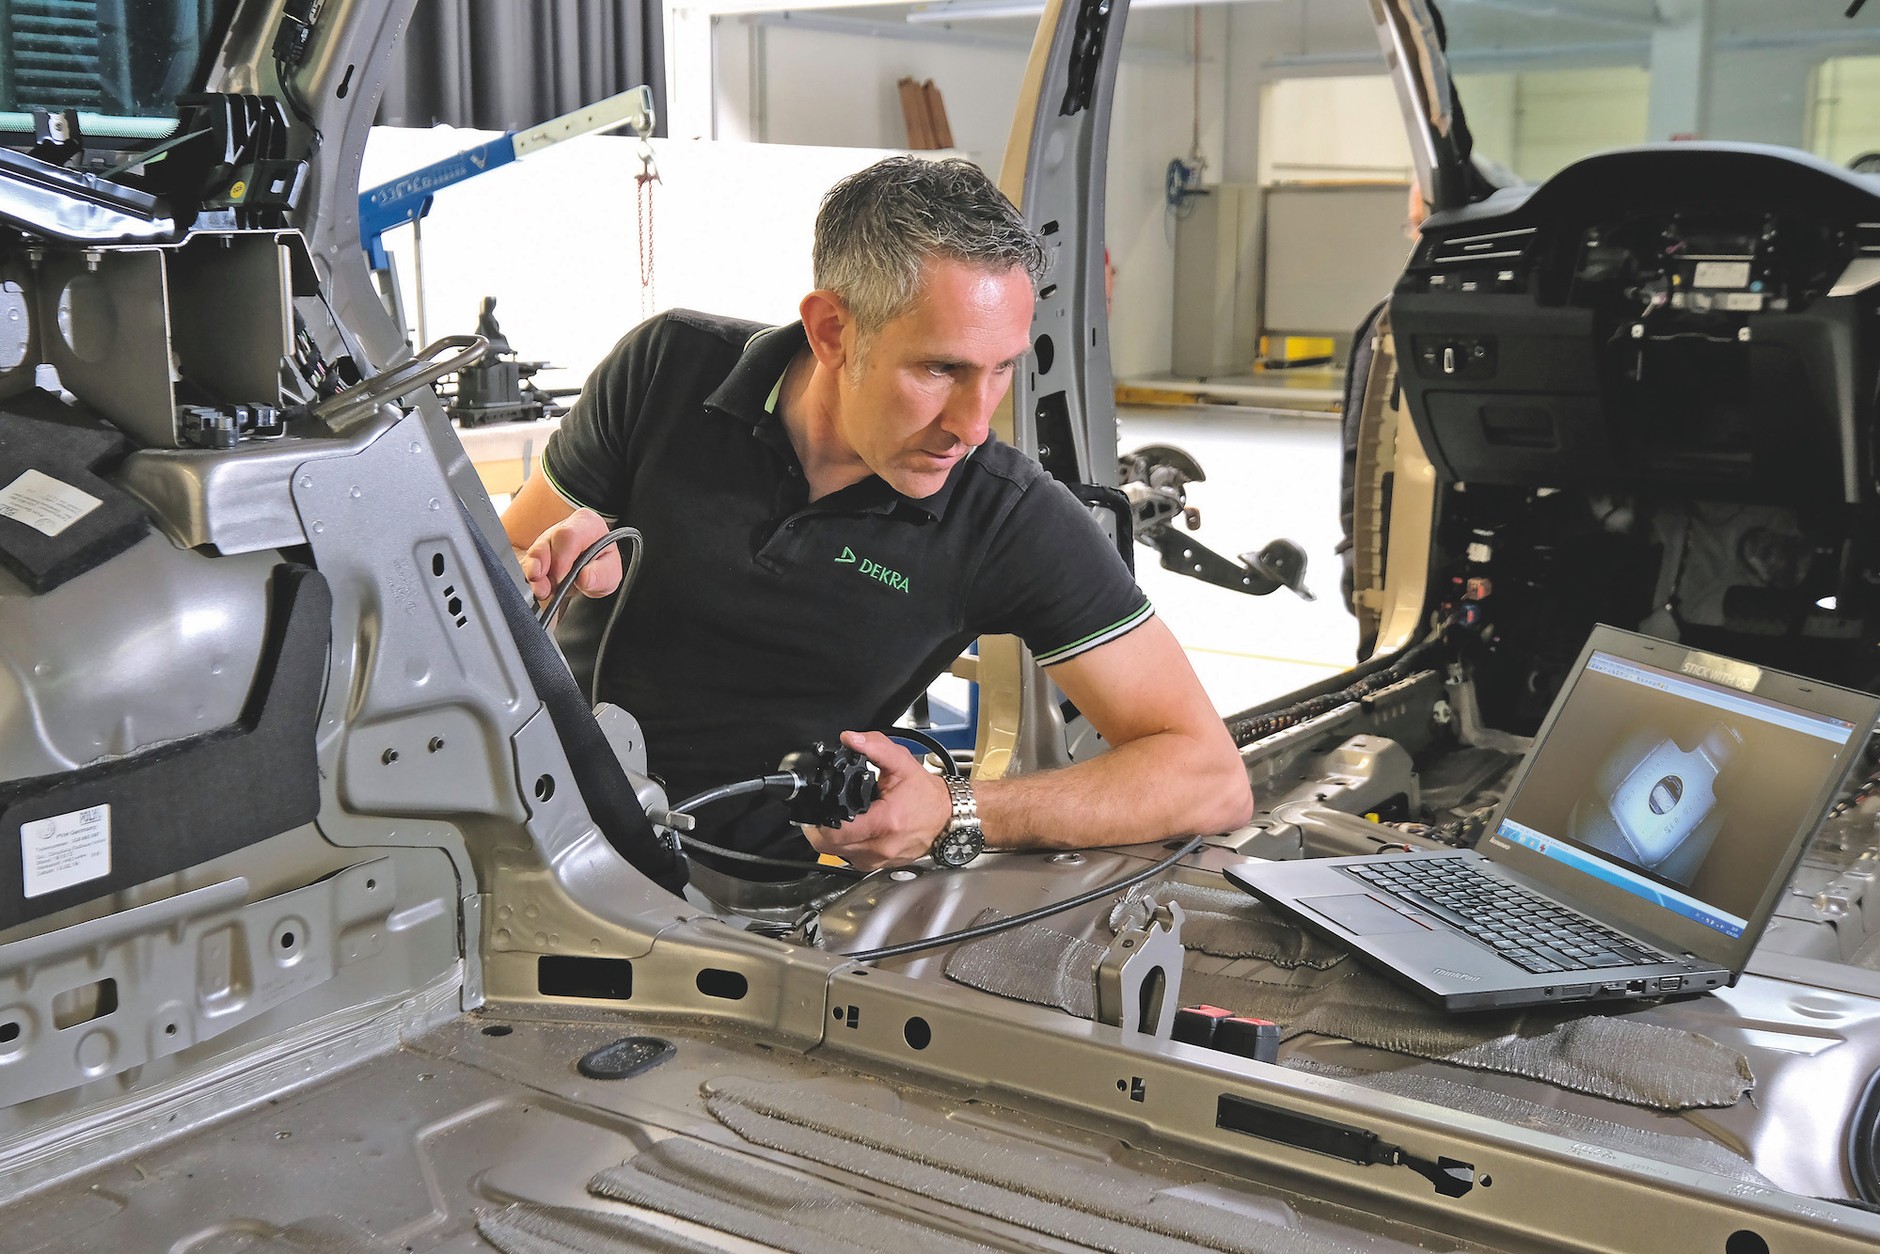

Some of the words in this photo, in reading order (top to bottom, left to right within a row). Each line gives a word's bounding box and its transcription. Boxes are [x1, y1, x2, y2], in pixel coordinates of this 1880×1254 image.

[858, 558, 909, 594] DEKRA
[1682, 662, 1710, 678] STICK
[1709, 669, 1736, 685] WITH
[1432, 967, 1482, 982] ThinkPad
